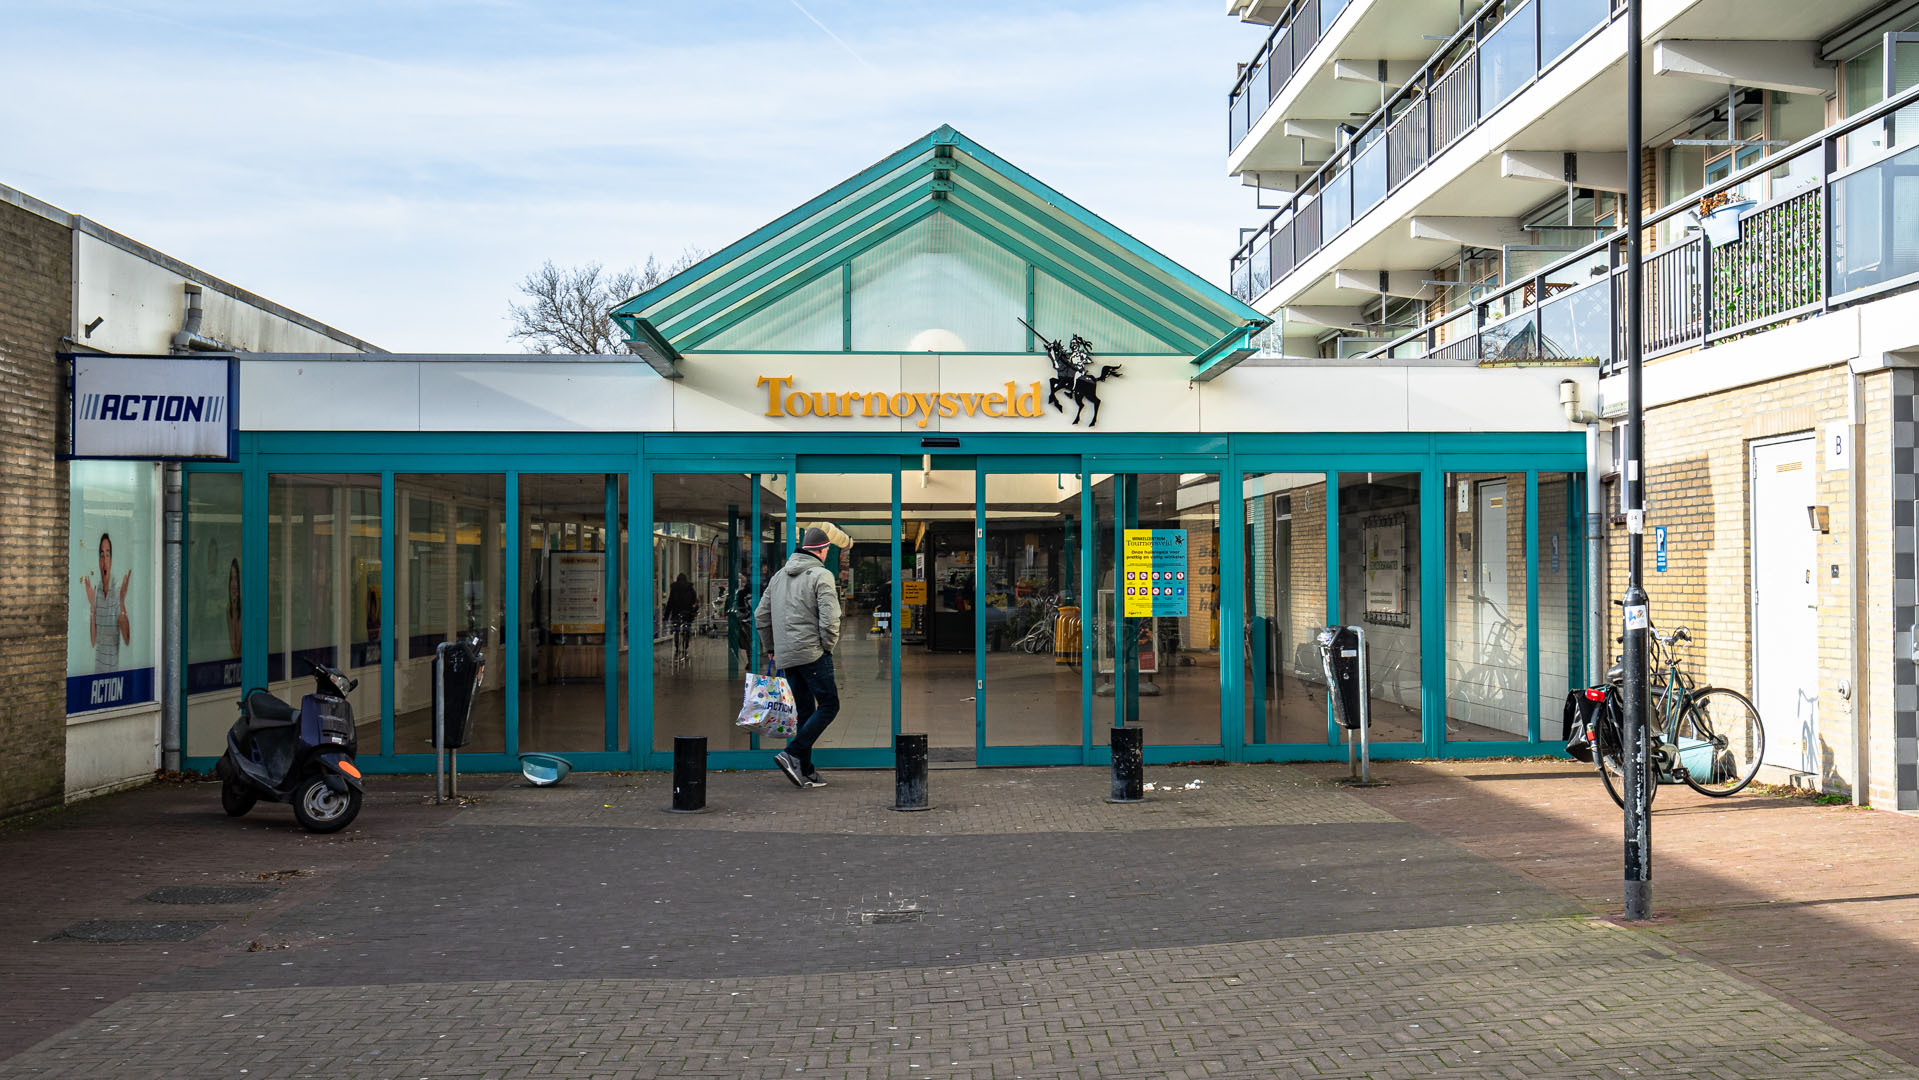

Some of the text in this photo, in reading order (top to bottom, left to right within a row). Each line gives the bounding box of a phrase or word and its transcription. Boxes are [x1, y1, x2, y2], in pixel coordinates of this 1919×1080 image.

[99, 394, 205, 422] ACTION
[756, 375, 1045, 427] Tournoysveld
[1836, 435, 1842, 455] B
[1657, 528, 1664, 551] P
[90, 676, 124, 705] ACTION
[767, 701, 793, 714] ACTION
